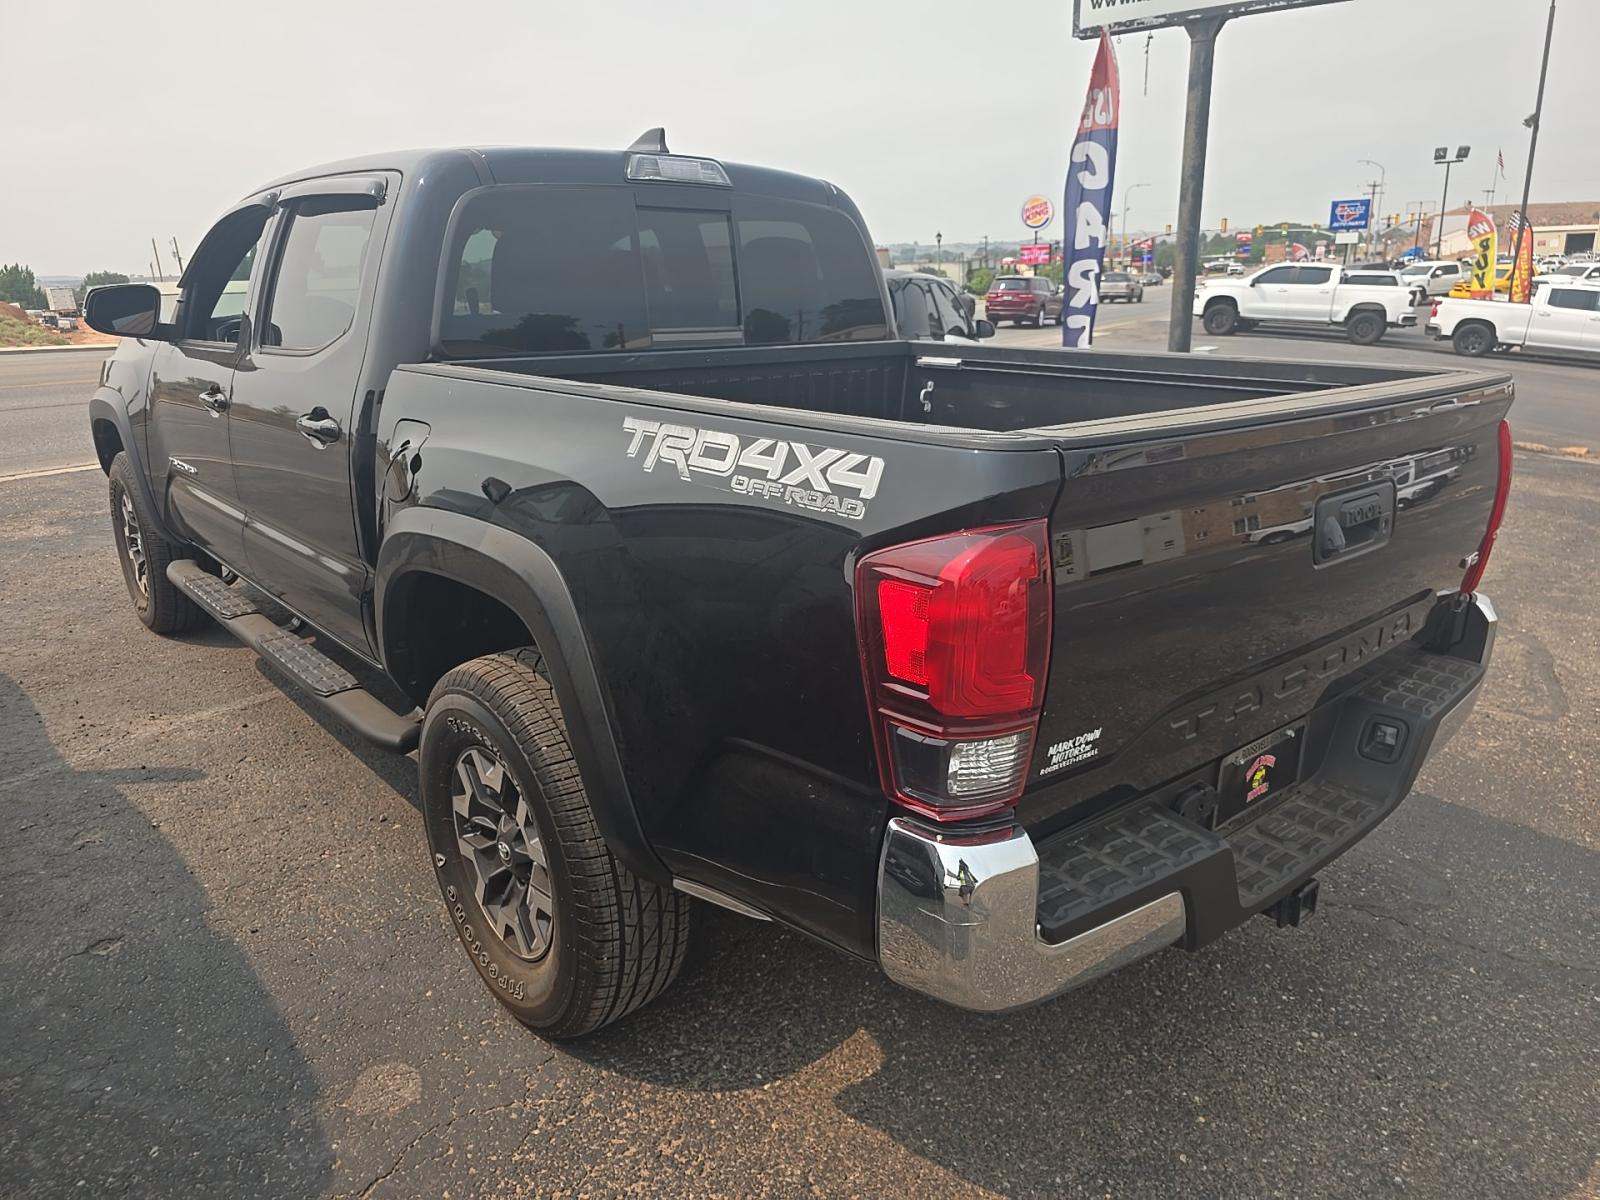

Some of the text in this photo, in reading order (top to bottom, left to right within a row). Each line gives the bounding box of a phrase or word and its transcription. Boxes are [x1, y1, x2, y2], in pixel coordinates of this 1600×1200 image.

[784, 485, 866, 520] ROAD
[1170, 611, 1412, 740] TACOMA
[1047, 727, 1103, 757] MARK DOWN
[446, 884, 525, 1001] Firestone
